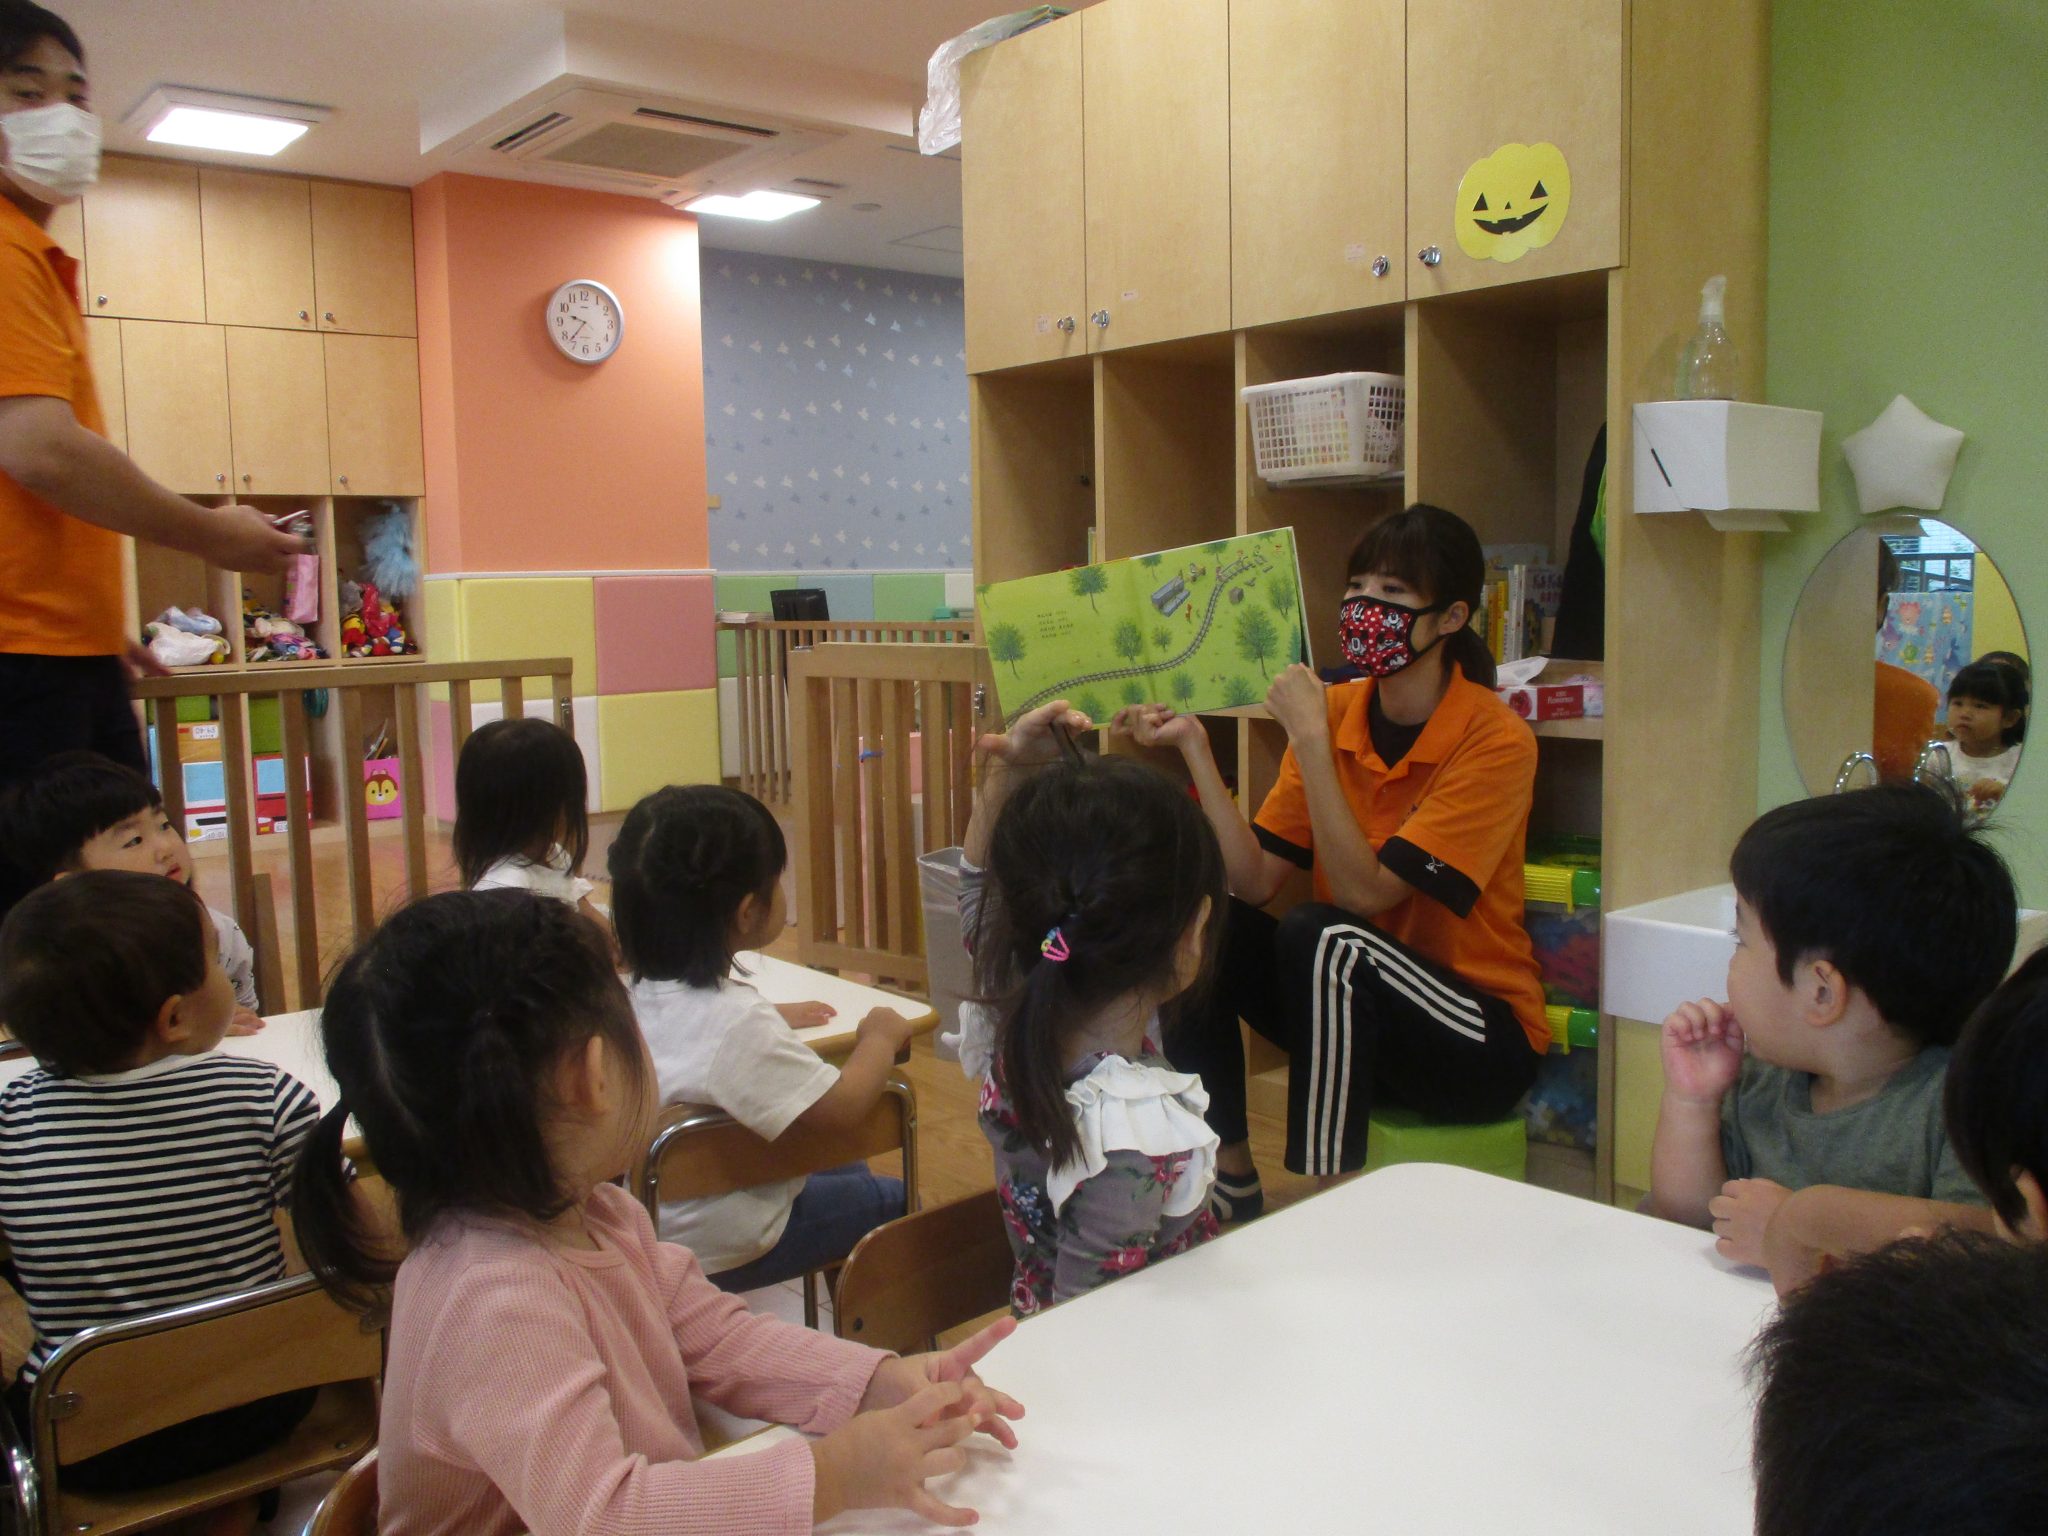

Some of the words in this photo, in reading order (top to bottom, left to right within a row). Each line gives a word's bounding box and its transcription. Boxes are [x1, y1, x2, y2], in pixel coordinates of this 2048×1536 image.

[568, 293, 576, 303] 11
[580, 291, 589, 301] 12
[560, 302, 569, 313] 10
[602, 305, 609, 316] 2
[556, 316, 564, 327] 9
[607, 320, 614, 329] 3
[561, 331, 569, 341] 8
[603, 333, 609, 342] 4
[582, 345, 589, 354] 6
[595, 343, 601, 352] 5
